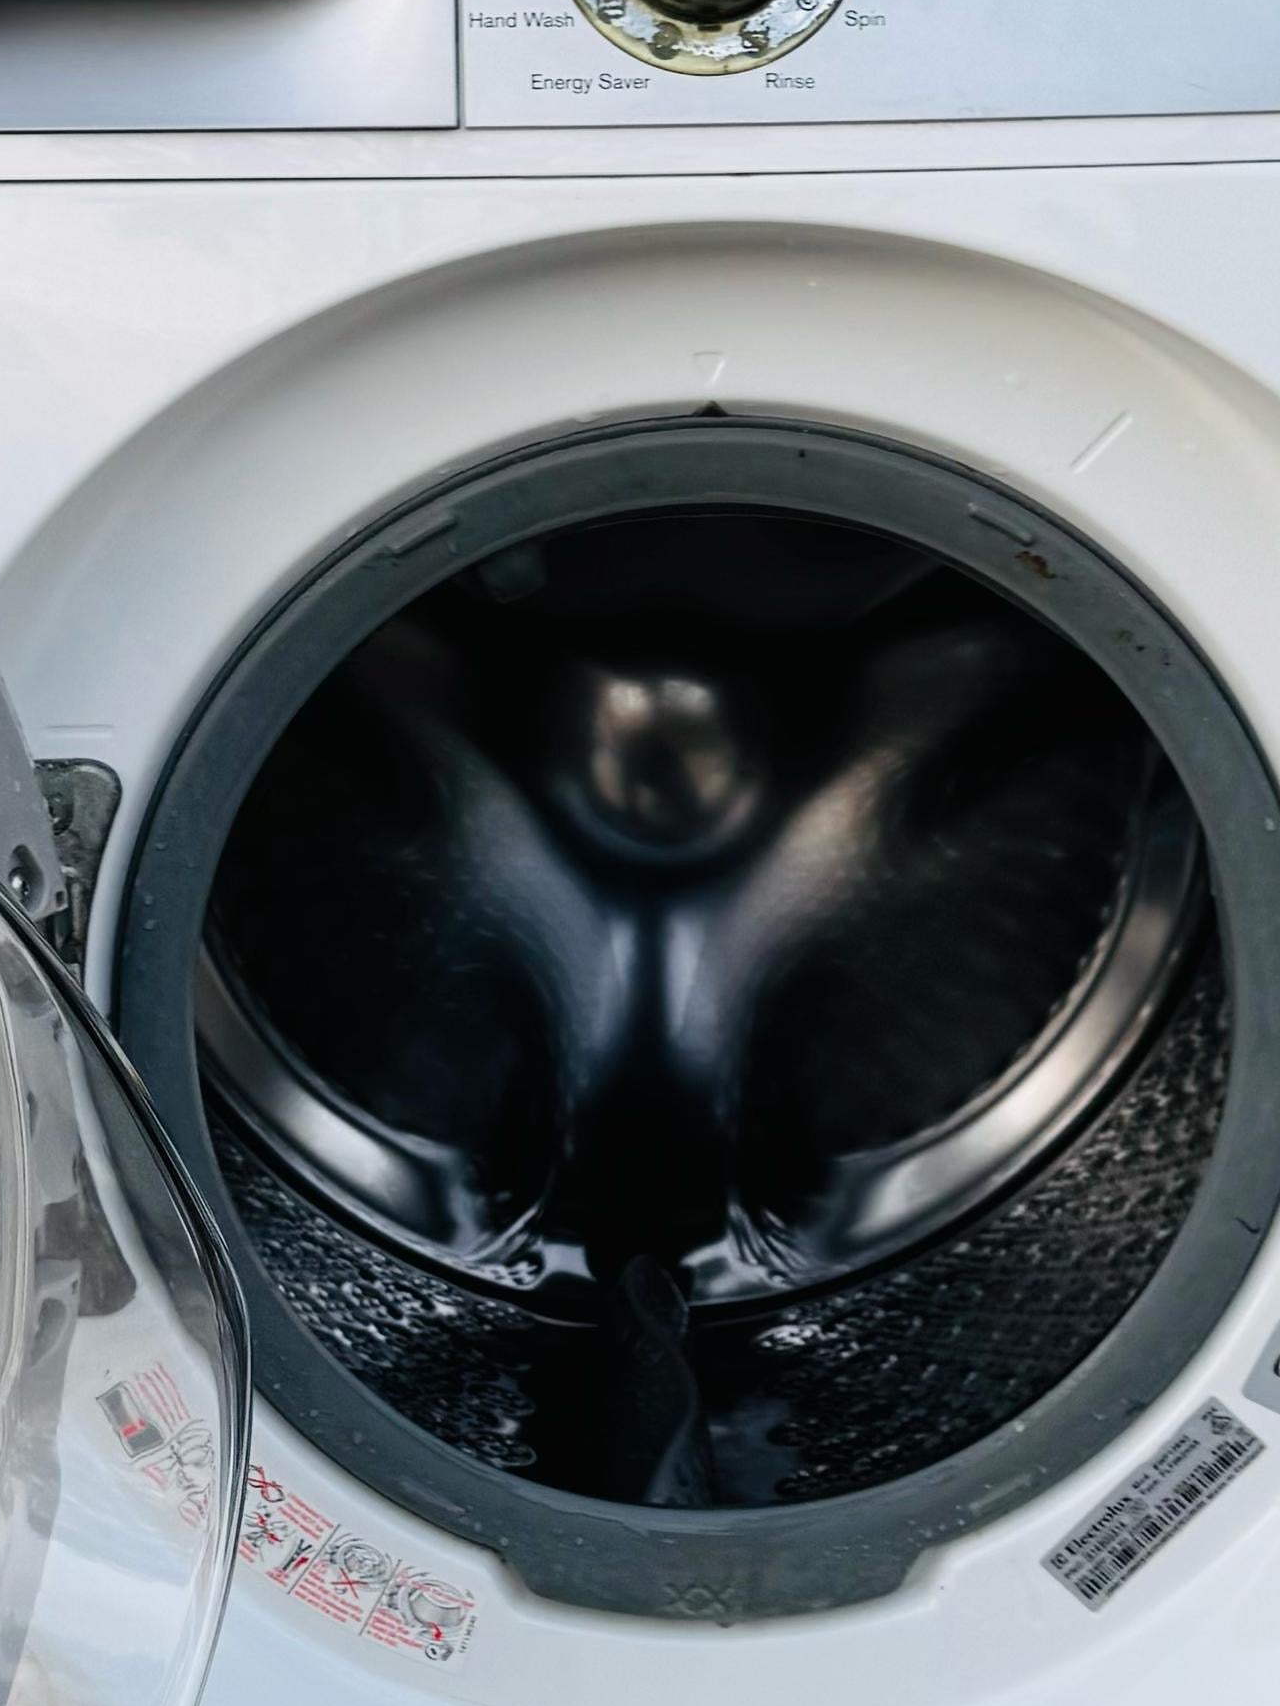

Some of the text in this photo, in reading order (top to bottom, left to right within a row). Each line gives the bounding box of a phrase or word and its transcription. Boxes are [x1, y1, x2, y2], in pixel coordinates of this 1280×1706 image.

[469, 12, 575, 28] Hand Wash
[844, 10, 886, 30] Spin
[531, 73, 651, 93] Energy Saver
[765, 73, 816, 89] Rinse
